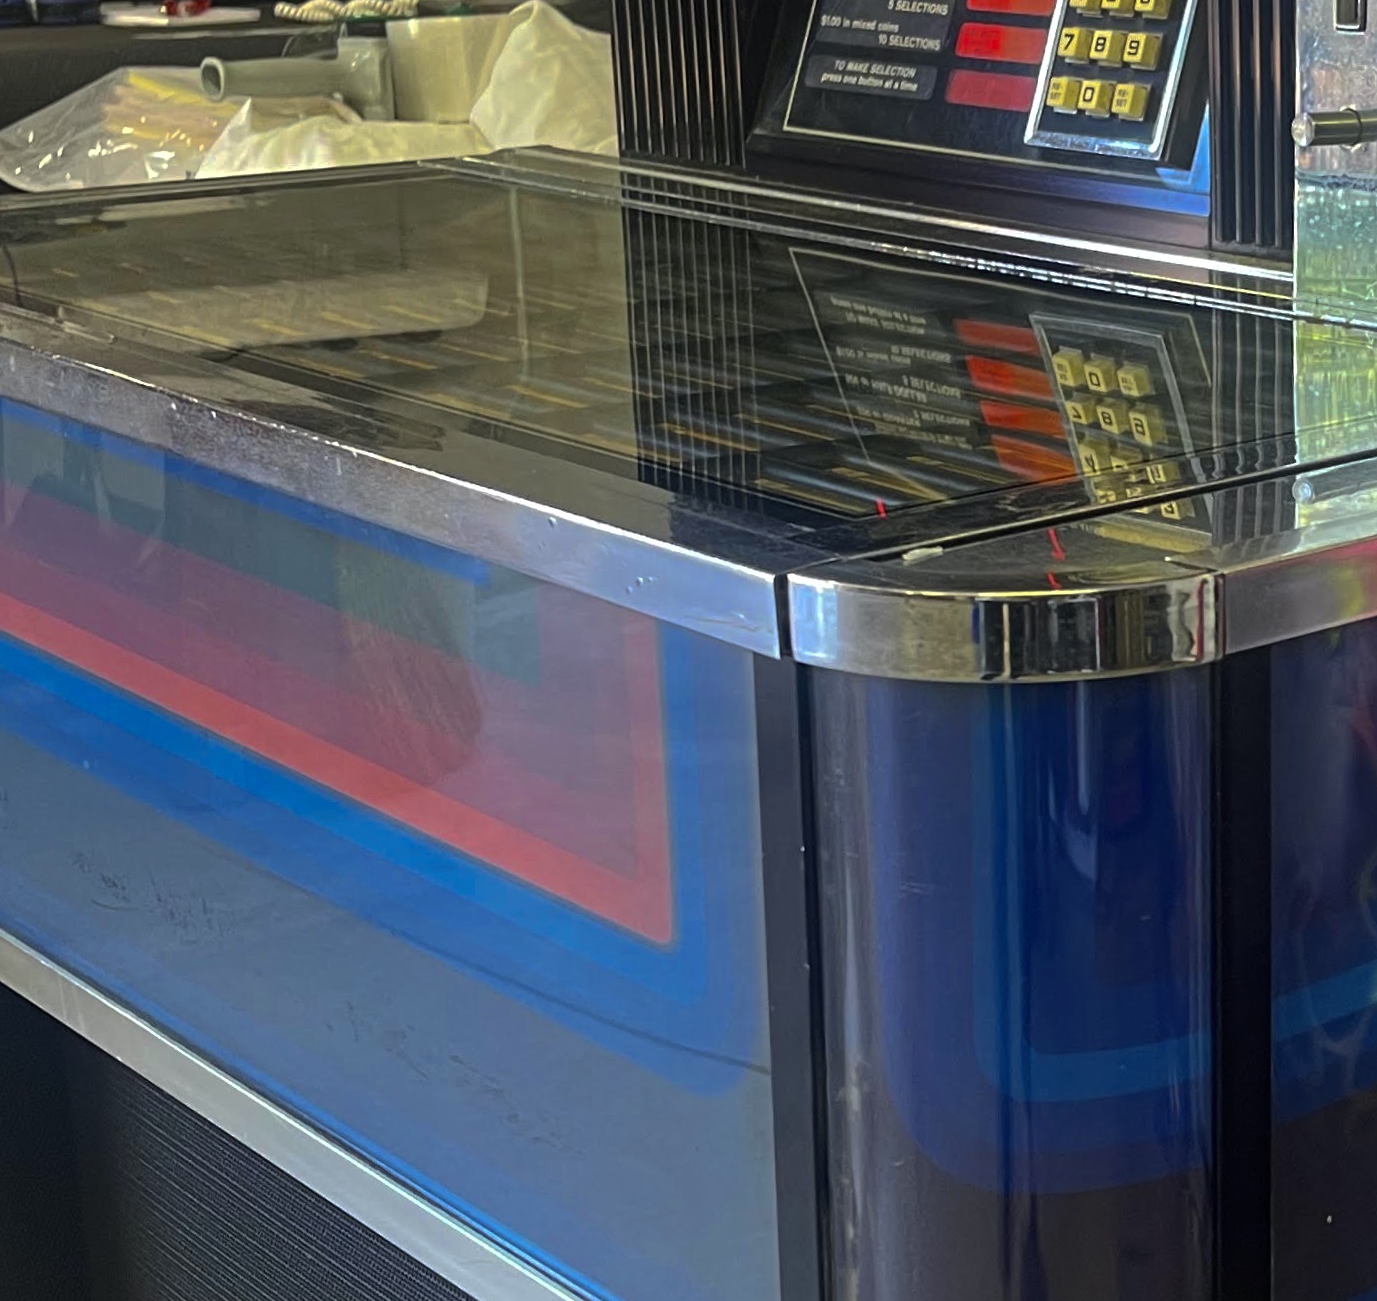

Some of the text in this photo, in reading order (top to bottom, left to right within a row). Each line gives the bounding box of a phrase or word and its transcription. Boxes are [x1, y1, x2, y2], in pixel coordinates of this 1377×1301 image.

[895, 1, 949, 16] SELECTIONS
[878, 21, 900, 32] coins
[878, 34, 941, 51] 10 SELECTIONS
[1064, 33, 1140, 56] 7 8 9
[834, 60, 916, 78] TO MAKE SELECTION
[820, 73, 842, 83] press
[843, 75, 857, 85] one
[858, 76, 883, 87] button
[900, 80, 918, 92] time
[1082, 87, 1095, 102] 0
